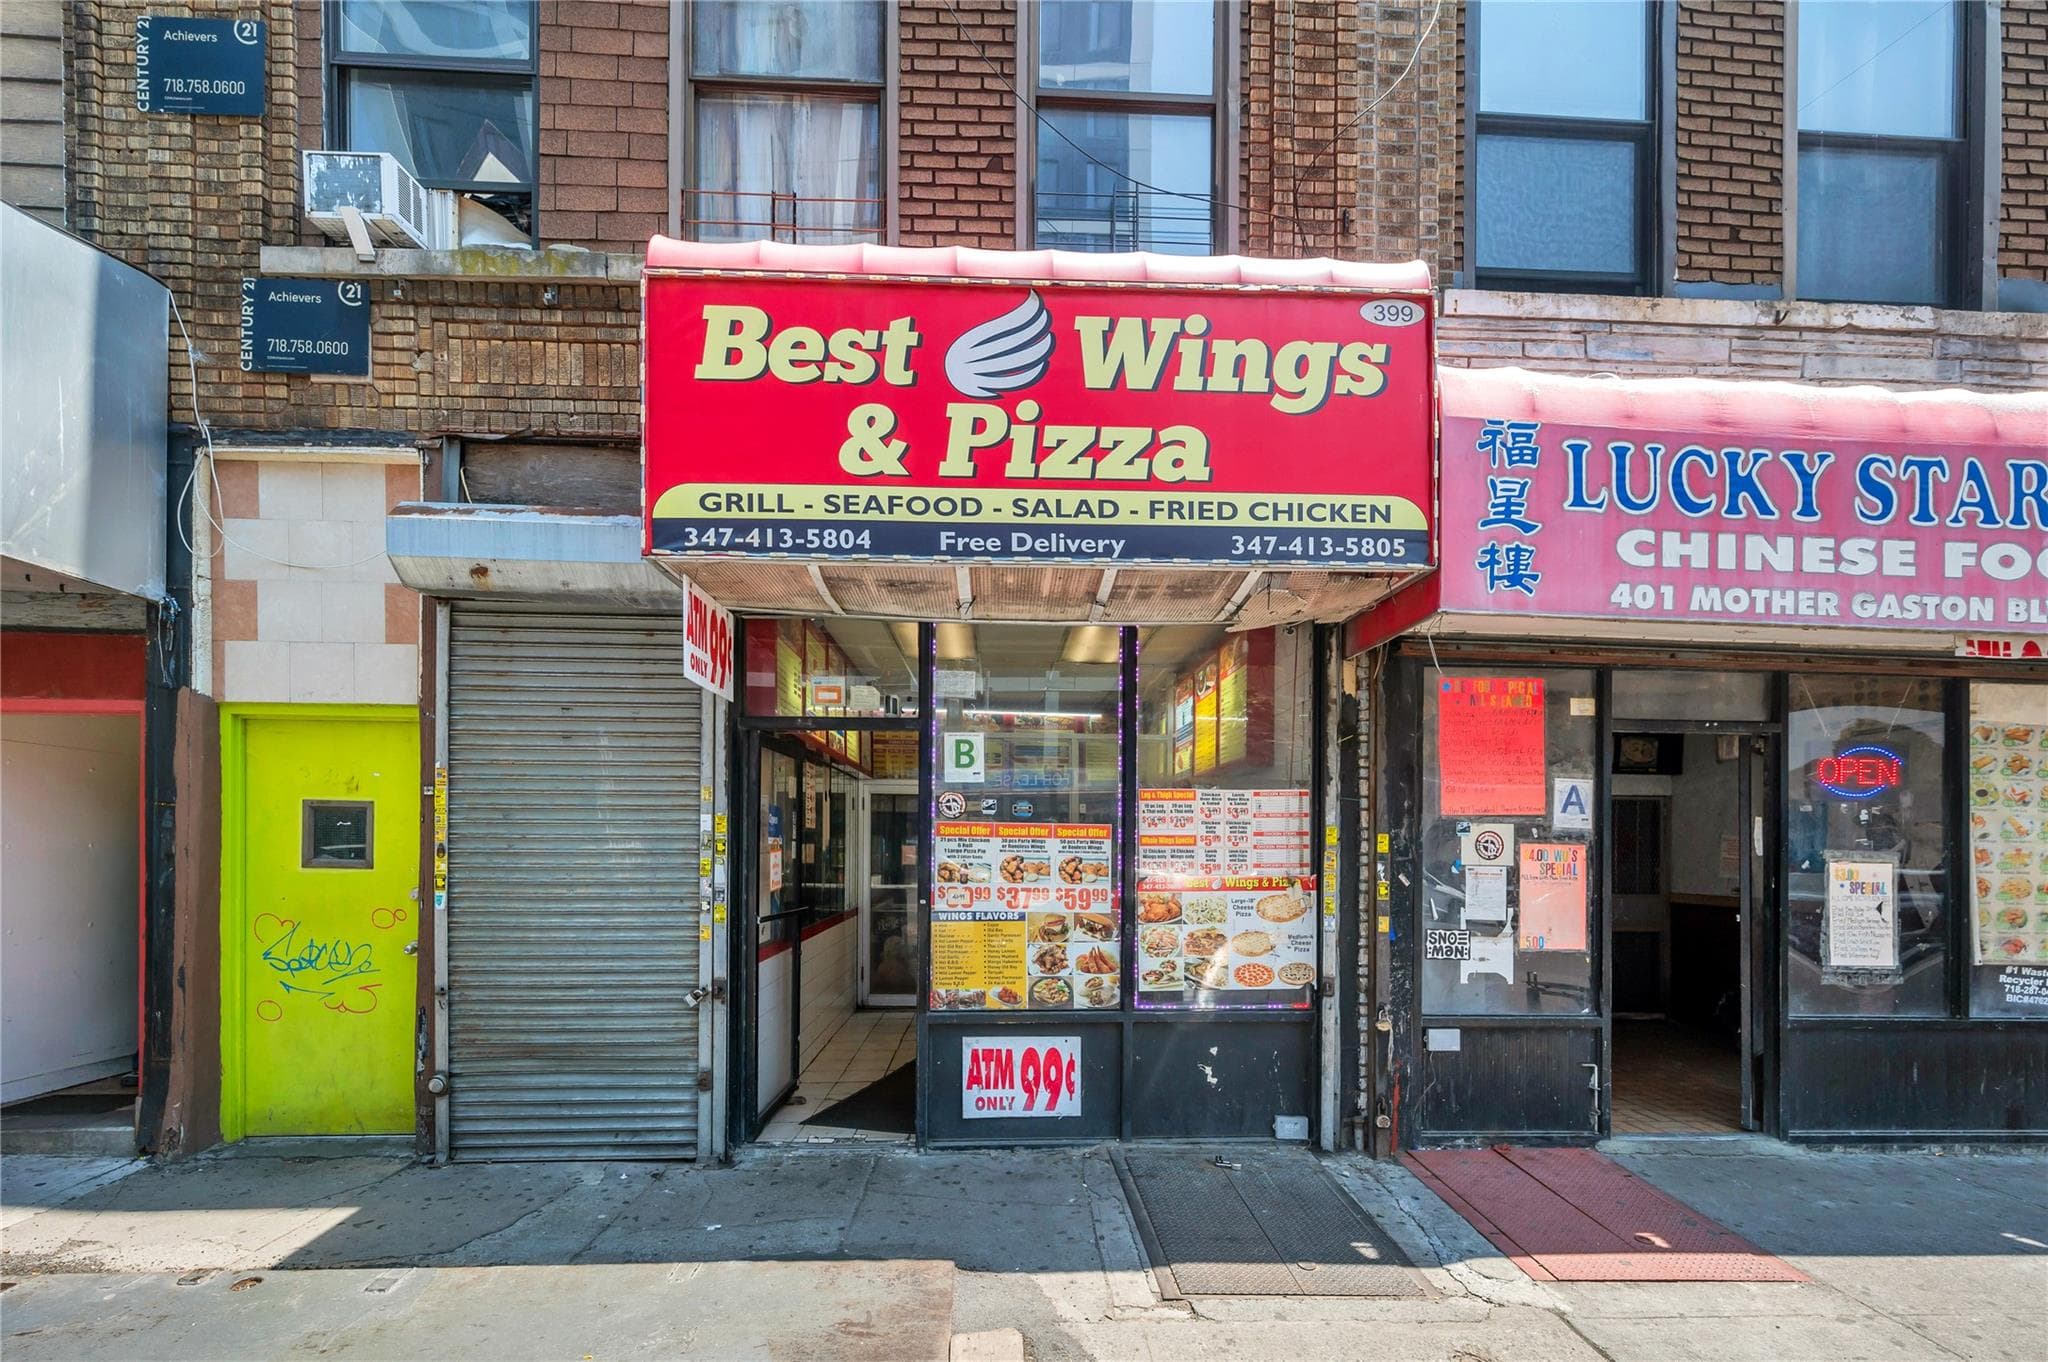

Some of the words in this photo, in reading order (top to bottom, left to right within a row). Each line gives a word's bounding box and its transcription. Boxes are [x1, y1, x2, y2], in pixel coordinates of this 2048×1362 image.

[163, 30, 218, 43] Achievers
[137, 33, 150, 112] CENTURY
[163, 78, 246, 95] 718.758.0600
[268, 291, 322, 304] Achievers
[1373, 304, 1415, 323] 399
[240, 293, 254, 371] CENTURY
[267, 338, 349, 356] 718.758.0600
[694, 304, 922, 388] Best
[1074, 313, 1392, 416] Wings
[838, 402, 912, 478] &
[938, 399, 1212, 484] Pizza
[1562, 439, 1836, 522] LUCKY
[1854, 453, 2048, 531] STAR
[698, 492, 795, 515] GRILL
[823, 494, 984, 518] SEAFOOD
[1012, 497, 1119, 520] SALAD
[1149, 500, 1238, 521] FRIED
[1249, 502, 1392, 524] CHICKEN
[684, 527, 872, 550] 347-413-5804
[940, 530, 1001, 552] Free
[1011, 531, 1126, 558] Delivery
[1231, 535, 1406, 557] 347-413-5805
[1616, 529, 1916, 577] CHINESE
[1944, 542, 2048, 580] FO
[1610, 583, 1675, 610] 401
[1690, 586, 1840, 616] MOTHER
[1852, 593, 1994, 622] GASTON
[2007, 598, 2048, 624] BL
[686, 591, 708, 654] ATM
[690, 652, 708, 678] ONLY
[954, 739, 975, 769] B
[1817, 757, 1902, 786] OPEN
[1560, 784, 1586, 815] A
[940, 826, 970, 837] Special
[972, 826, 991, 836] Offer
[999, 827, 1028, 838] Special
[1029, 827, 1049, 837] Offer
[1057, 828, 1086, 839] Special
[1088, 828, 1108, 838] Offer
[1540, 862, 1578, 876] SPECIAL
[1225, 876, 1259, 890] Wings
[1262, 877, 1269, 888] &
[938, 912, 972, 921] WINGS
[975, 912, 1019, 921] FLAVORS
[1999, 974, 2045, 986] Recycler
[2005, 965, 2019, 974] #1
[2004, 984, 2048, 996] 718-287-0
[966, 1048, 1015, 1090] ATM
[1020, 1047, 1077, 1112] 99¢
[975, 1096, 1016, 1111] ONLY
